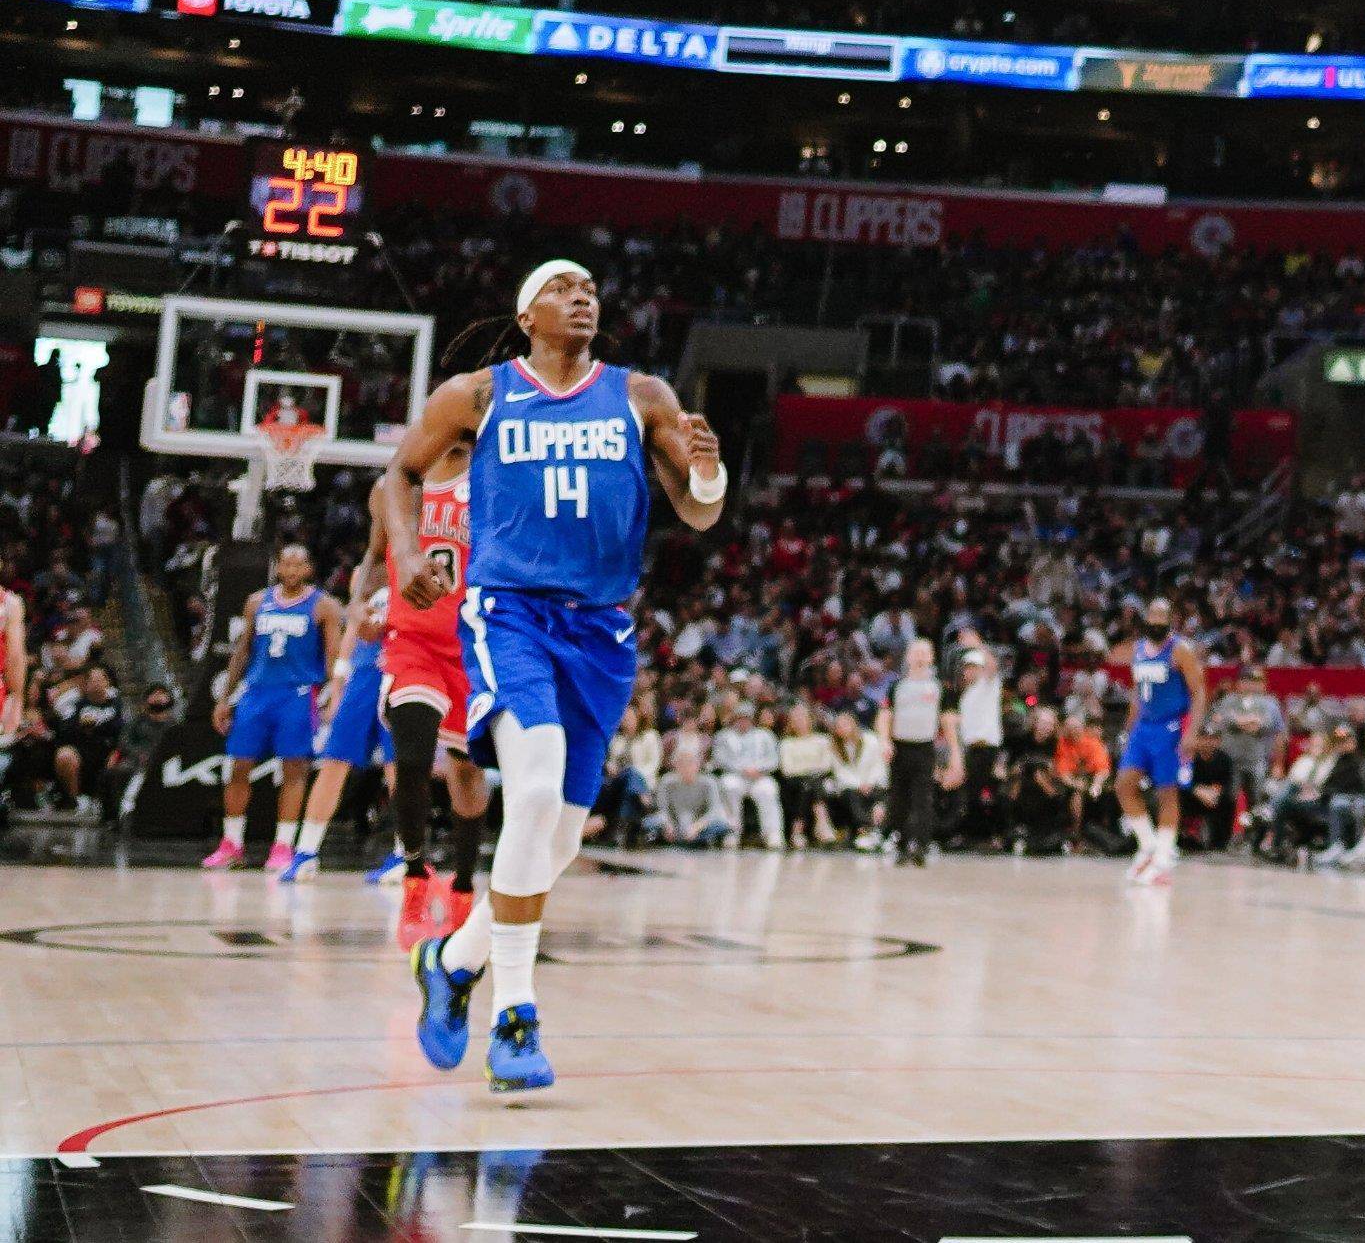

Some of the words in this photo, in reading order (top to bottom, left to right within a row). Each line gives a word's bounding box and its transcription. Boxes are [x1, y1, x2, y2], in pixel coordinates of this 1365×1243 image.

[428, 7, 515, 42] Sprite
[587, 24, 710, 59] DELTA
[948, 54, 1059, 77] crypto.com
[282, 147, 358, 186] 4:40
[263, 177, 348, 237] 22
[812, 193, 943, 246] CLIPPERS
[498, 417, 628, 464] CLIPPERS
[543, 464, 590, 519] 14
